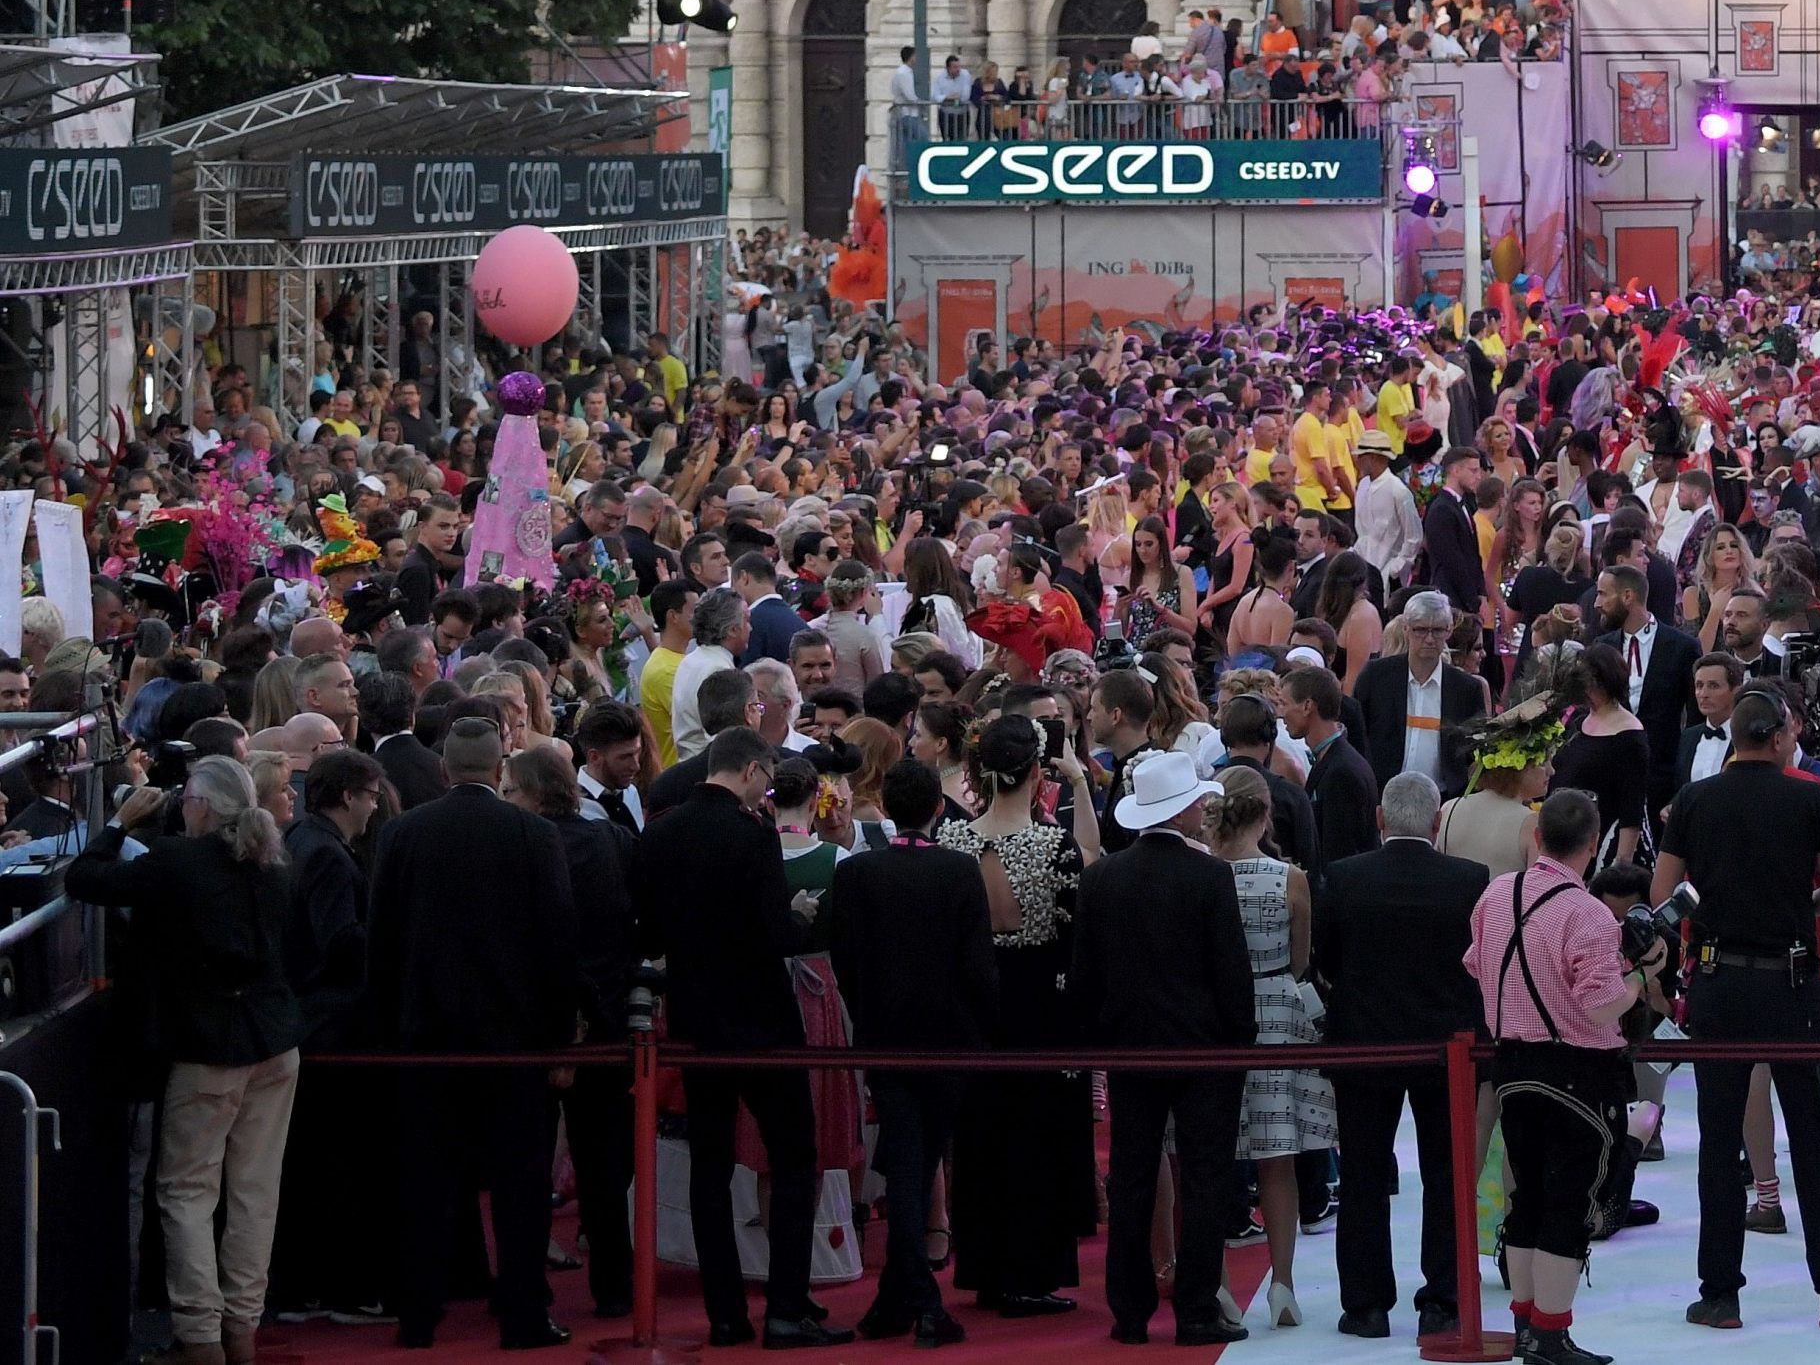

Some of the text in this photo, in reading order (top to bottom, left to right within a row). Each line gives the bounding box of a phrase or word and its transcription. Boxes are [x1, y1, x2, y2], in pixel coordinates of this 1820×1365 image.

[1238, 161, 1340, 181] CSEED.TV
[1088, 261, 1194, 276] ING DiBa
